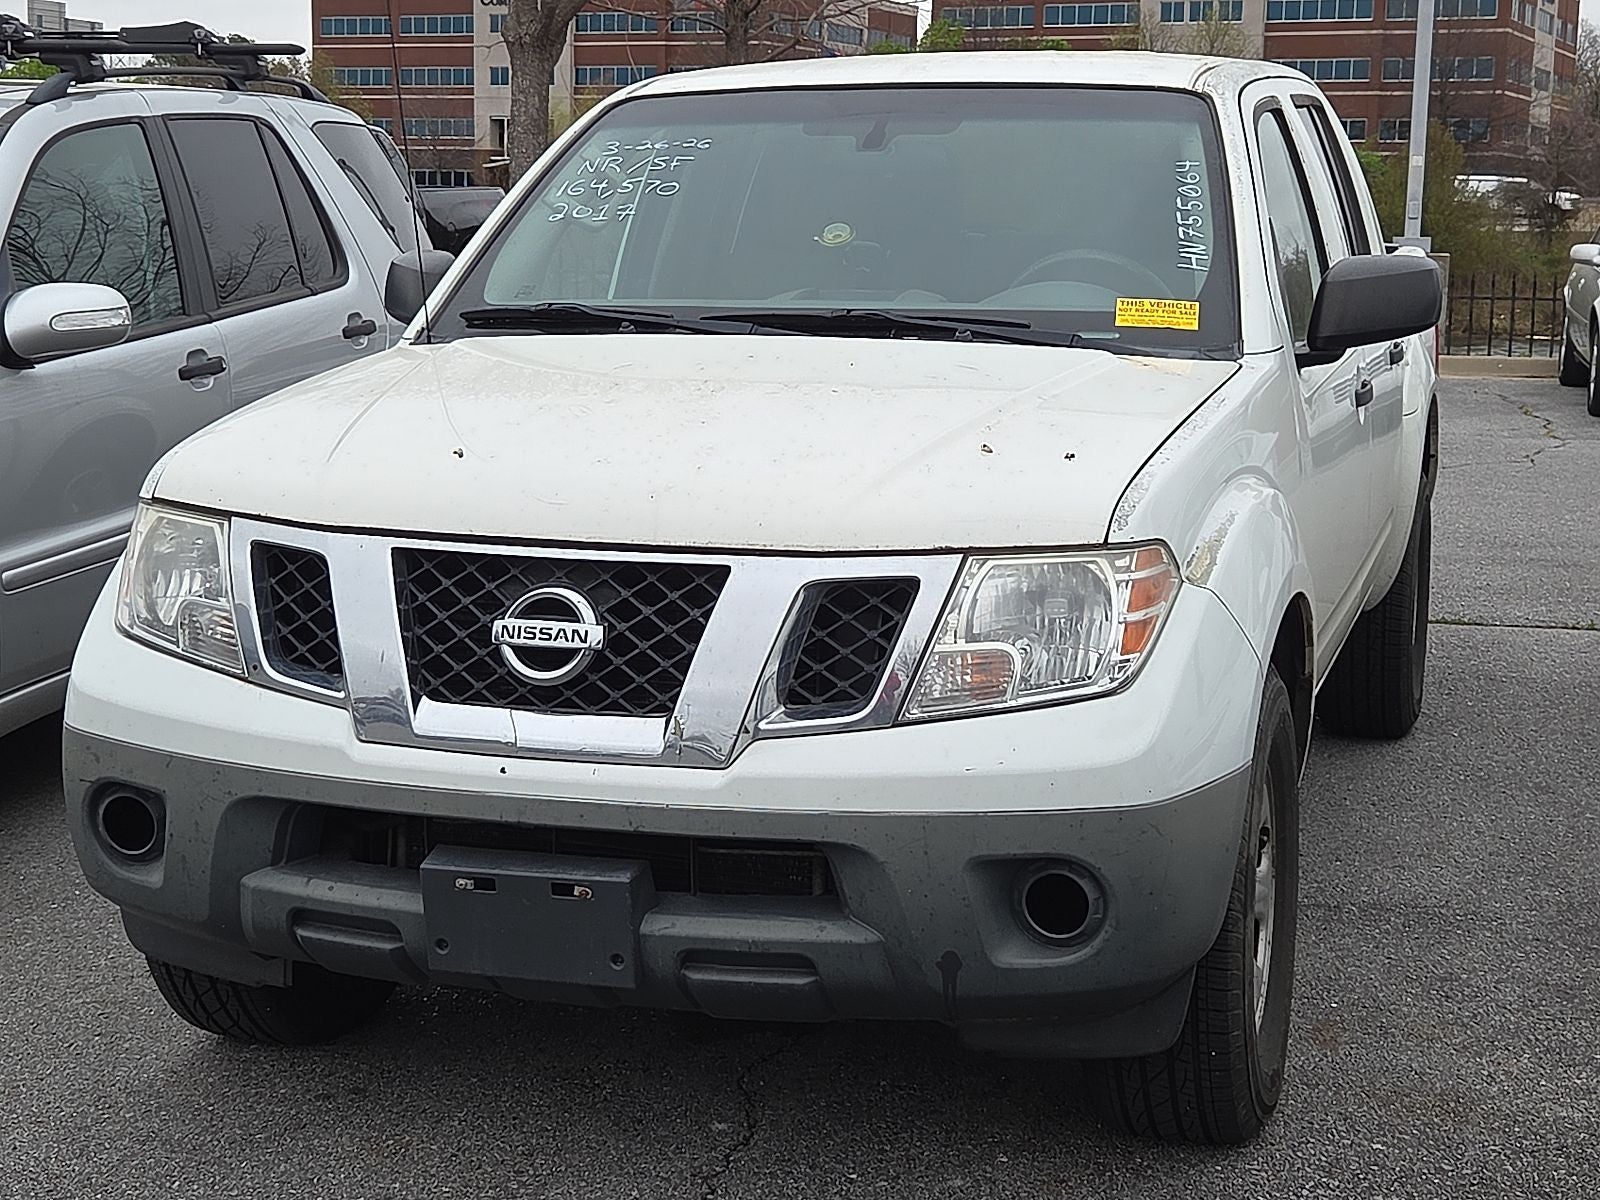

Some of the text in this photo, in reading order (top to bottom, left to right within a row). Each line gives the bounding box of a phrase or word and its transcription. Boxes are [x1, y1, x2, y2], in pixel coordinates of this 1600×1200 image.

[602, 138, 713, 156] 3-26-26
[555, 177, 681, 199] 164,570
[548, 202, 636, 222] 2017
[1176, 159, 1209, 271] HN755064
[1149, 301, 1197, 310] VEHICLE
[500, 624, 589, 644] NISSAN
